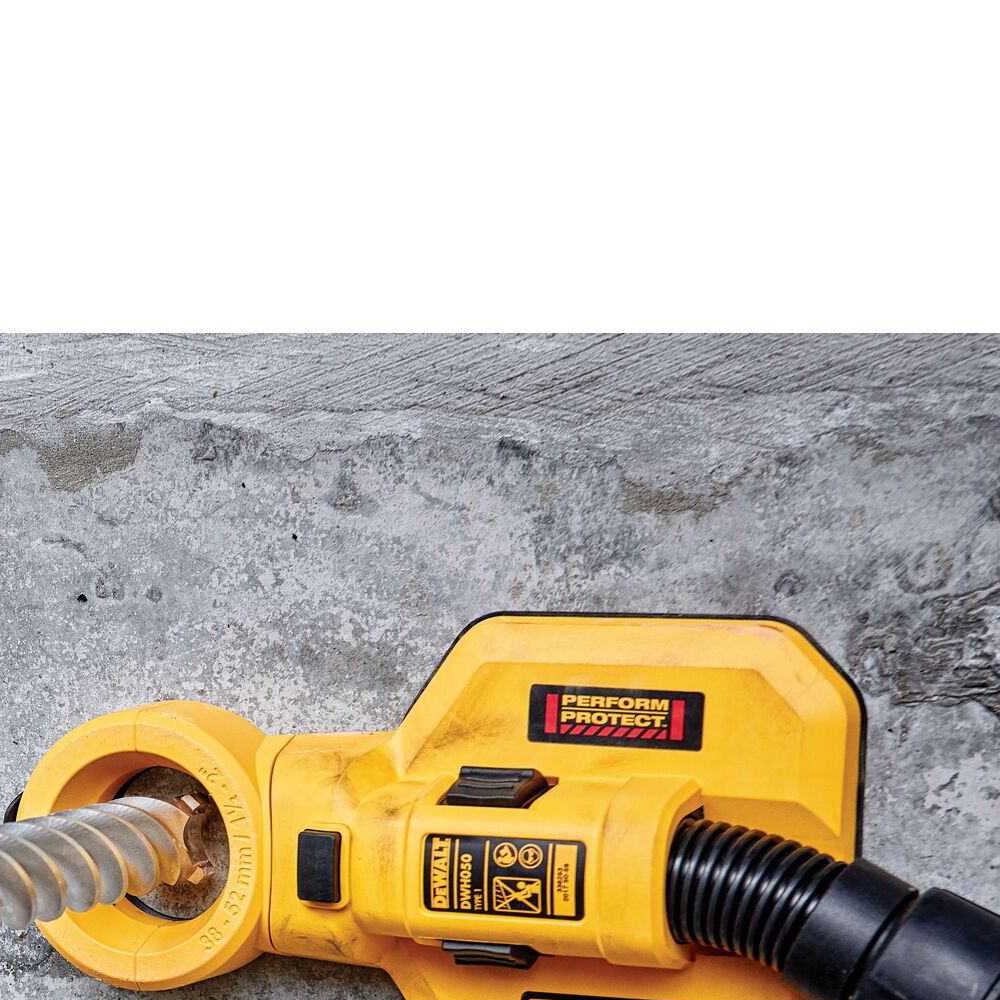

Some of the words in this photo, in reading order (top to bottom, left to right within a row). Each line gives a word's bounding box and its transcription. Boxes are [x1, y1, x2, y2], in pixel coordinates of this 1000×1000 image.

[561, 694, 670, 711] PERFORM
[199, 926, 223, 951] 38
[223, 890, 248, 918] 52
[236, 846, 253, 886] mm
[459, 853, 473, 910] DWH050
[473, 894, 483, 911] TYPE
